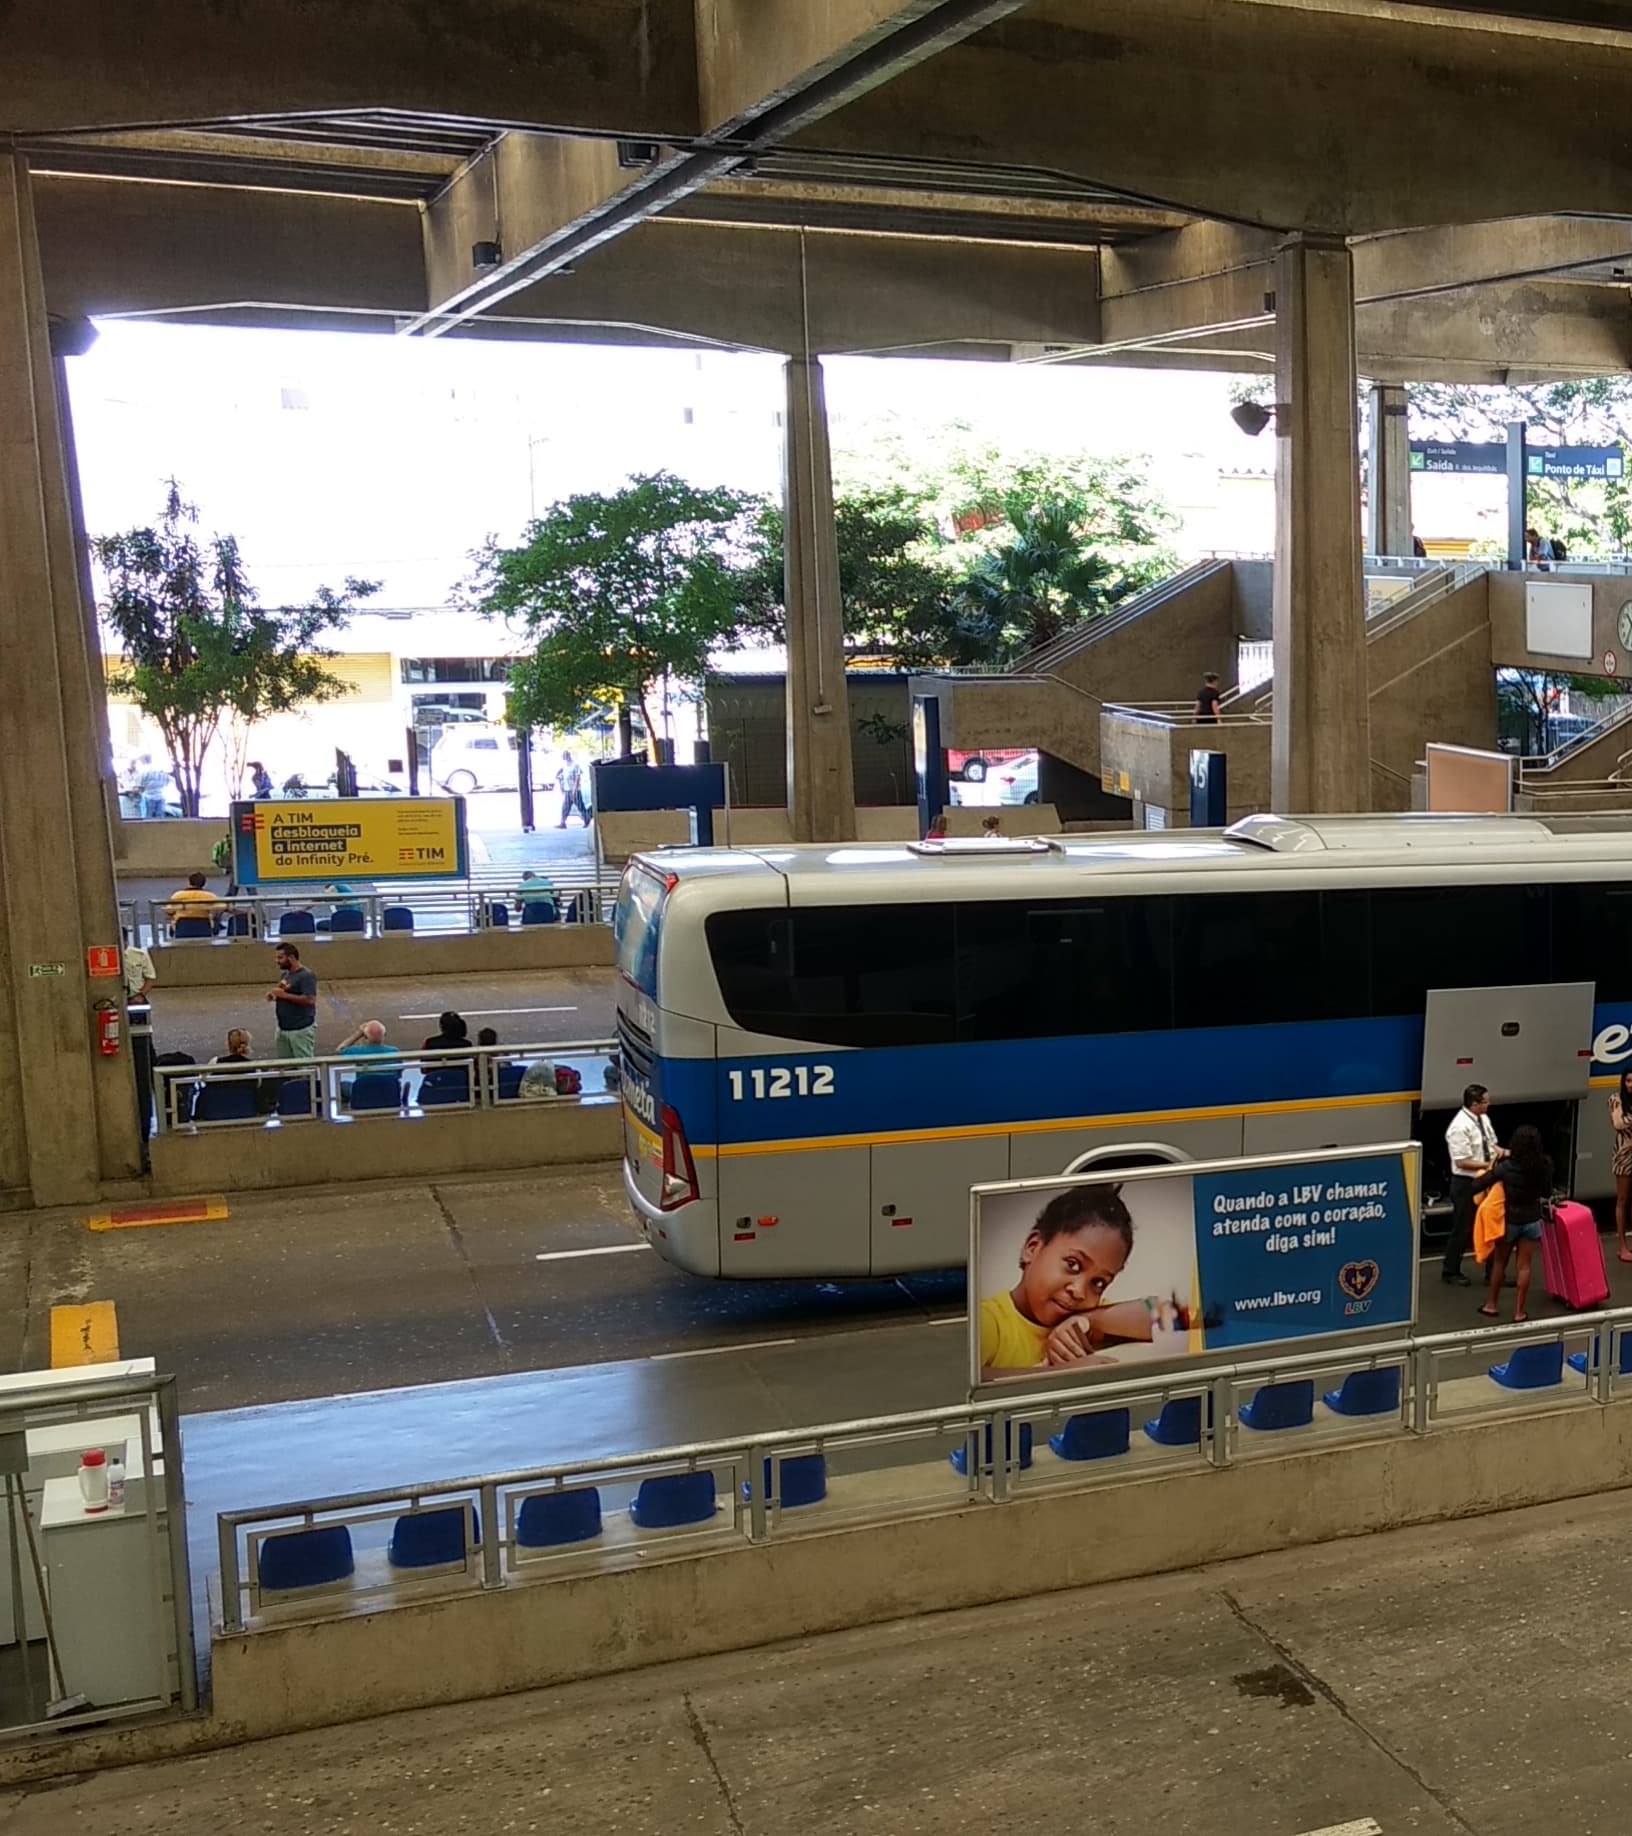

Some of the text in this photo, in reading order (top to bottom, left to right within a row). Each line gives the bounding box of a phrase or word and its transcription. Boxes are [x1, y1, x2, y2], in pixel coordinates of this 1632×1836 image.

[1545, 464, 1605, 475] Ponto de Táxi
[273, 812, 313, 824] A TIM
[273, 827, 359, 840] desbloqueia
[274, 838, 344, 852] a internet
[275, 851, 374, 868] do Infinity Pré.
[416, 847, 445, 860] TIM
[729, 1065, 835, 1101] 11212
[1213, 1181, 1388, 1213] Quando a LBV chamar,
[1212, 1201, 1387, 1236] atenda com o coração,
[1266, 1227, 1336, 1253] diga sim!
[1234, 1290, 1321, 1312] www.lbv.org
[1344, 1299, 1373, 1315] LBV
